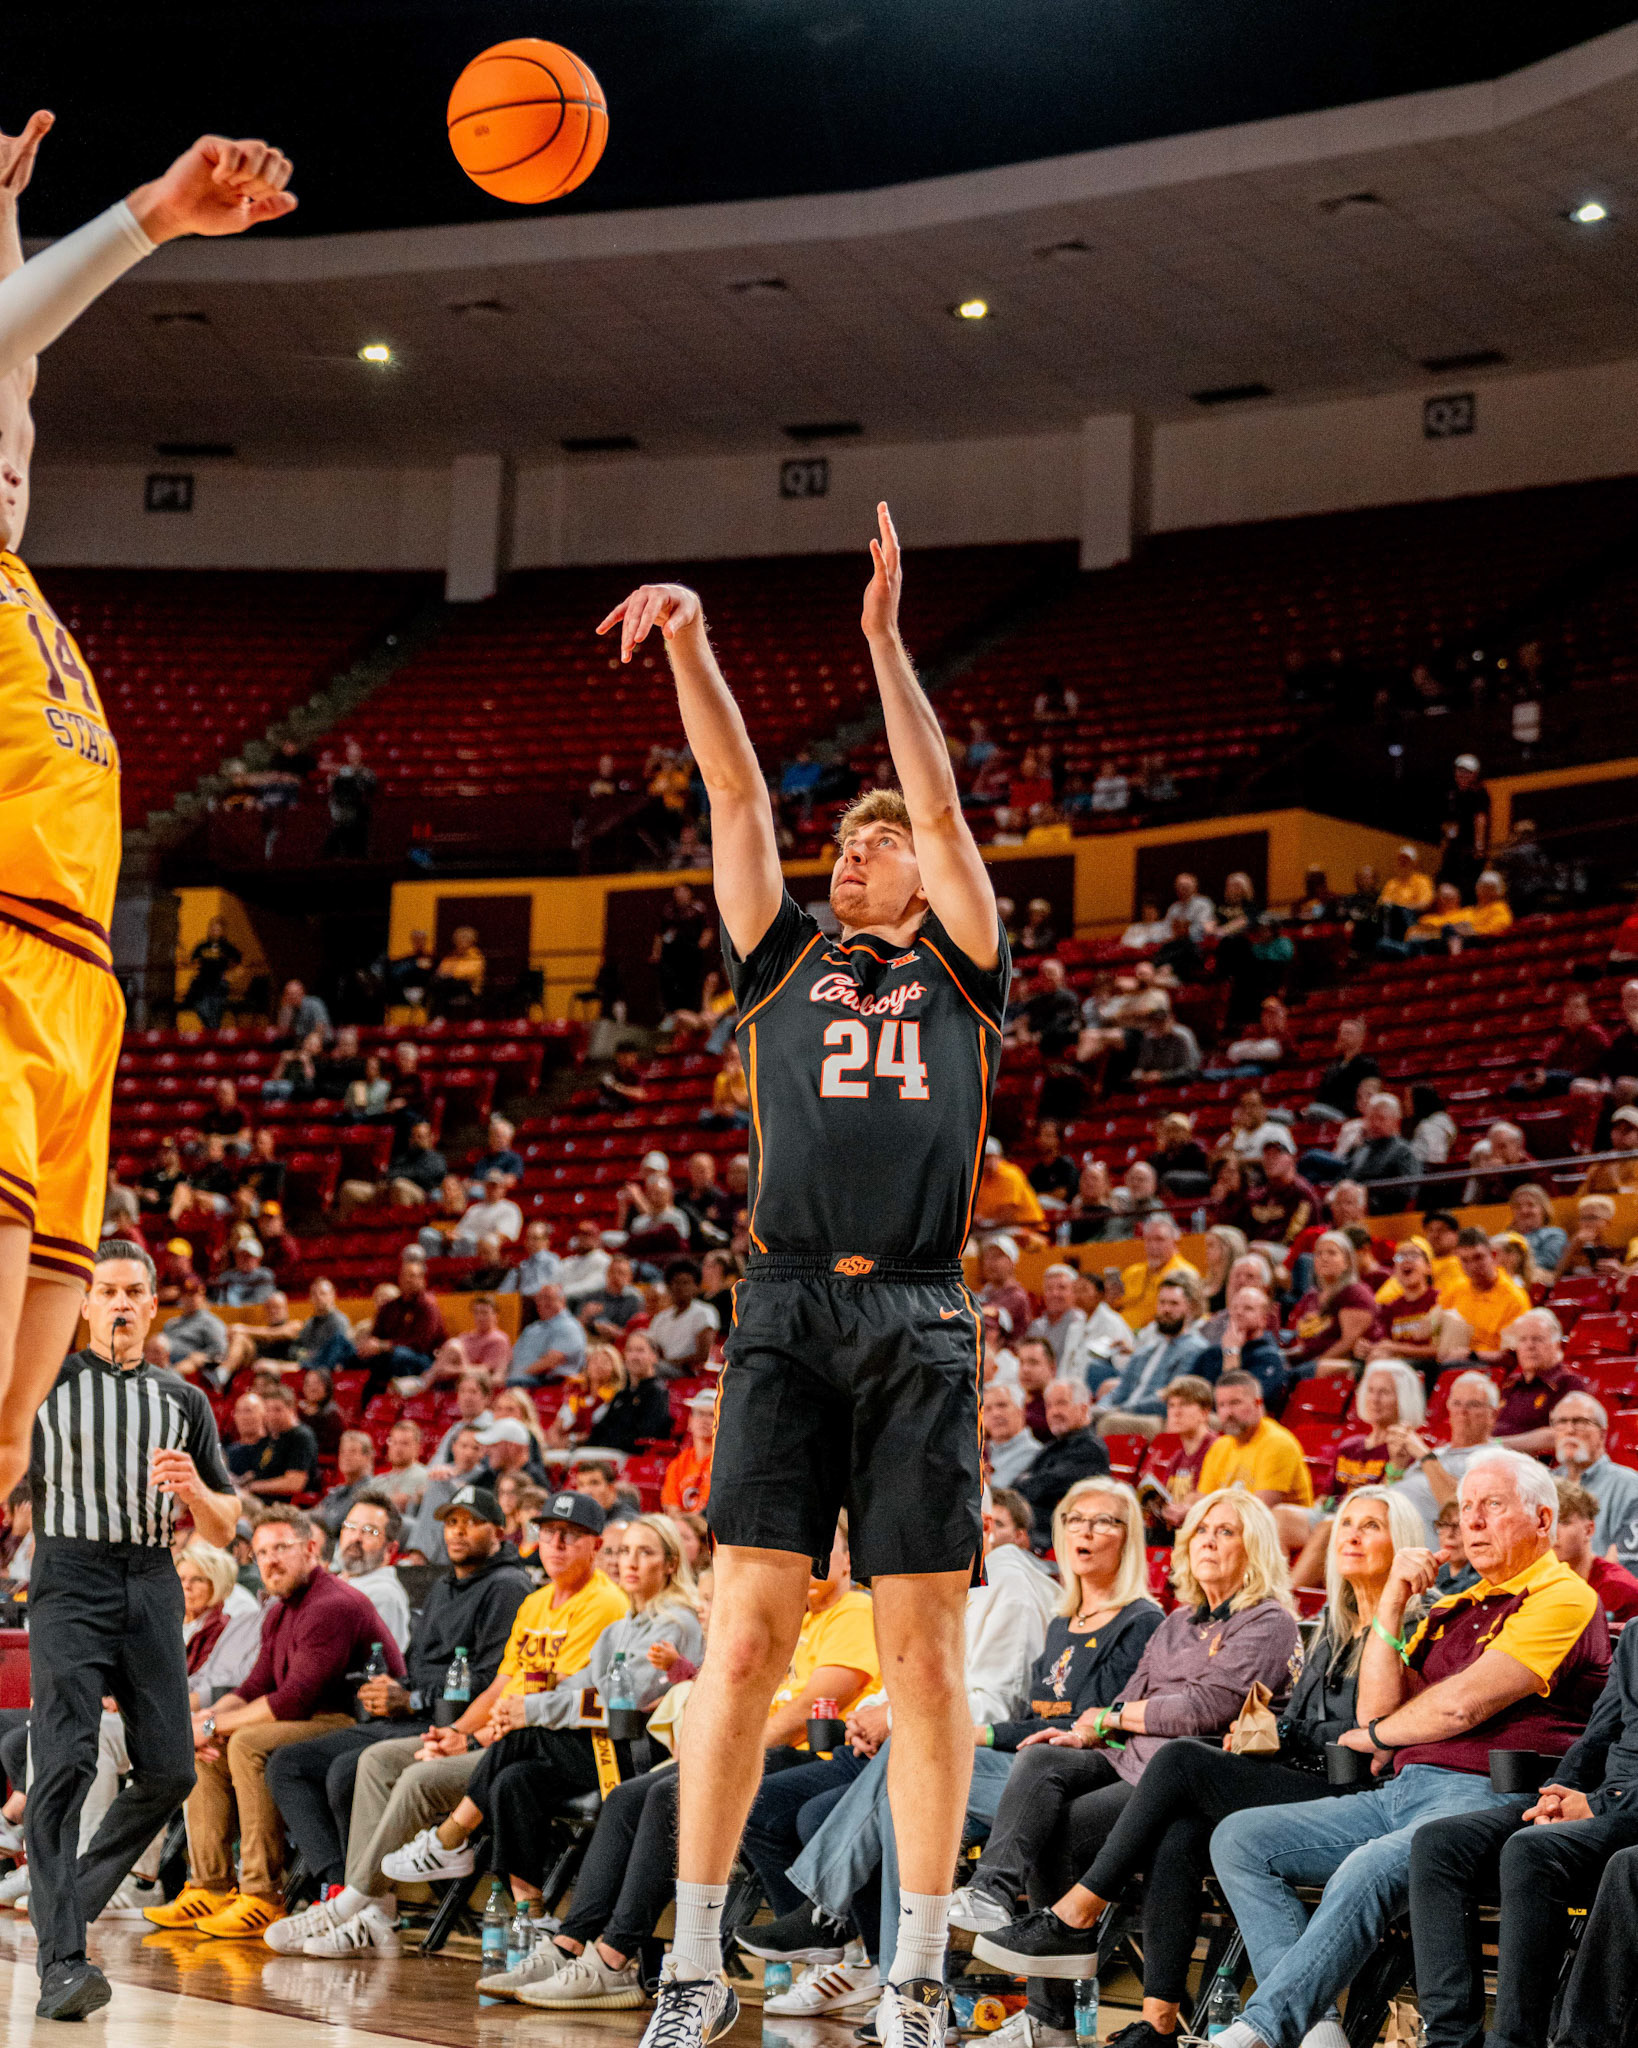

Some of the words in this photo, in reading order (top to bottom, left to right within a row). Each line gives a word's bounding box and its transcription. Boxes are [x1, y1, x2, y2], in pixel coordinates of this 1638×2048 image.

[27, 613, 98, 714] 14
[43, 706, 116, 769] STAT
[809, 972, 927, 1016] Cowboys
[820, 1018, 930, 1100] 24
[834, 1256, 875, 1276] OSU
